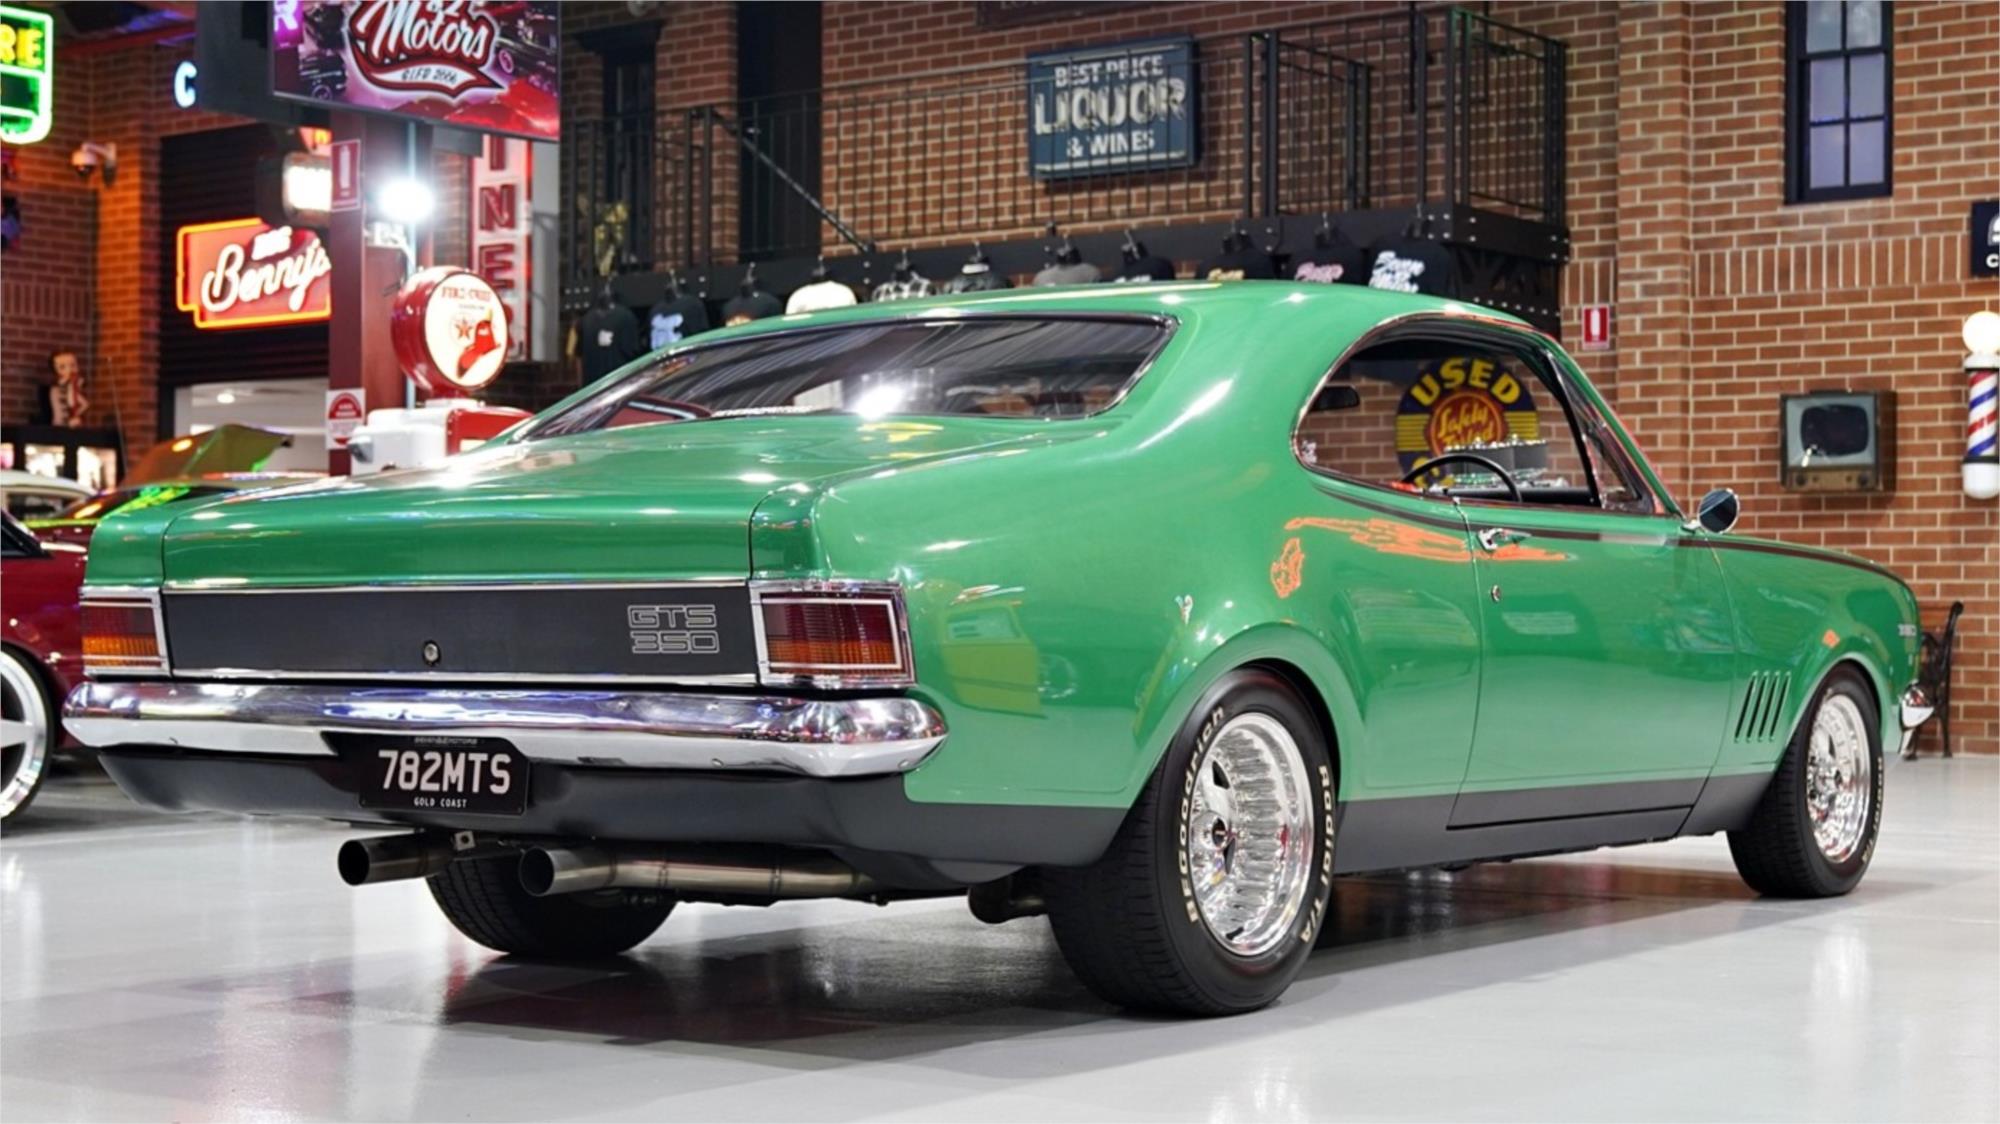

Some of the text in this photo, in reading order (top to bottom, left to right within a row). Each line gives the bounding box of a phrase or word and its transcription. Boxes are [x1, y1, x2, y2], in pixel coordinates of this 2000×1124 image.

[356, 1, 489, 59] Motors
[1055, 55, 1165, 87] BEST PRICE
[1035, 78, 1187, 134] LIQUOR
[1066, 130, 1155, 158] & WINES
[202, 238, 331, 312] Benny's
[1410, 356, 1520, 406] USED
[627, 604, 717, 629] GTS
[630, 630, 720, 654] 350
[378, 749, 511, 795] 782MTS
[414, 796, 468, 809] GOLD COAST
[1317, 764, 1335, 890] Radial
